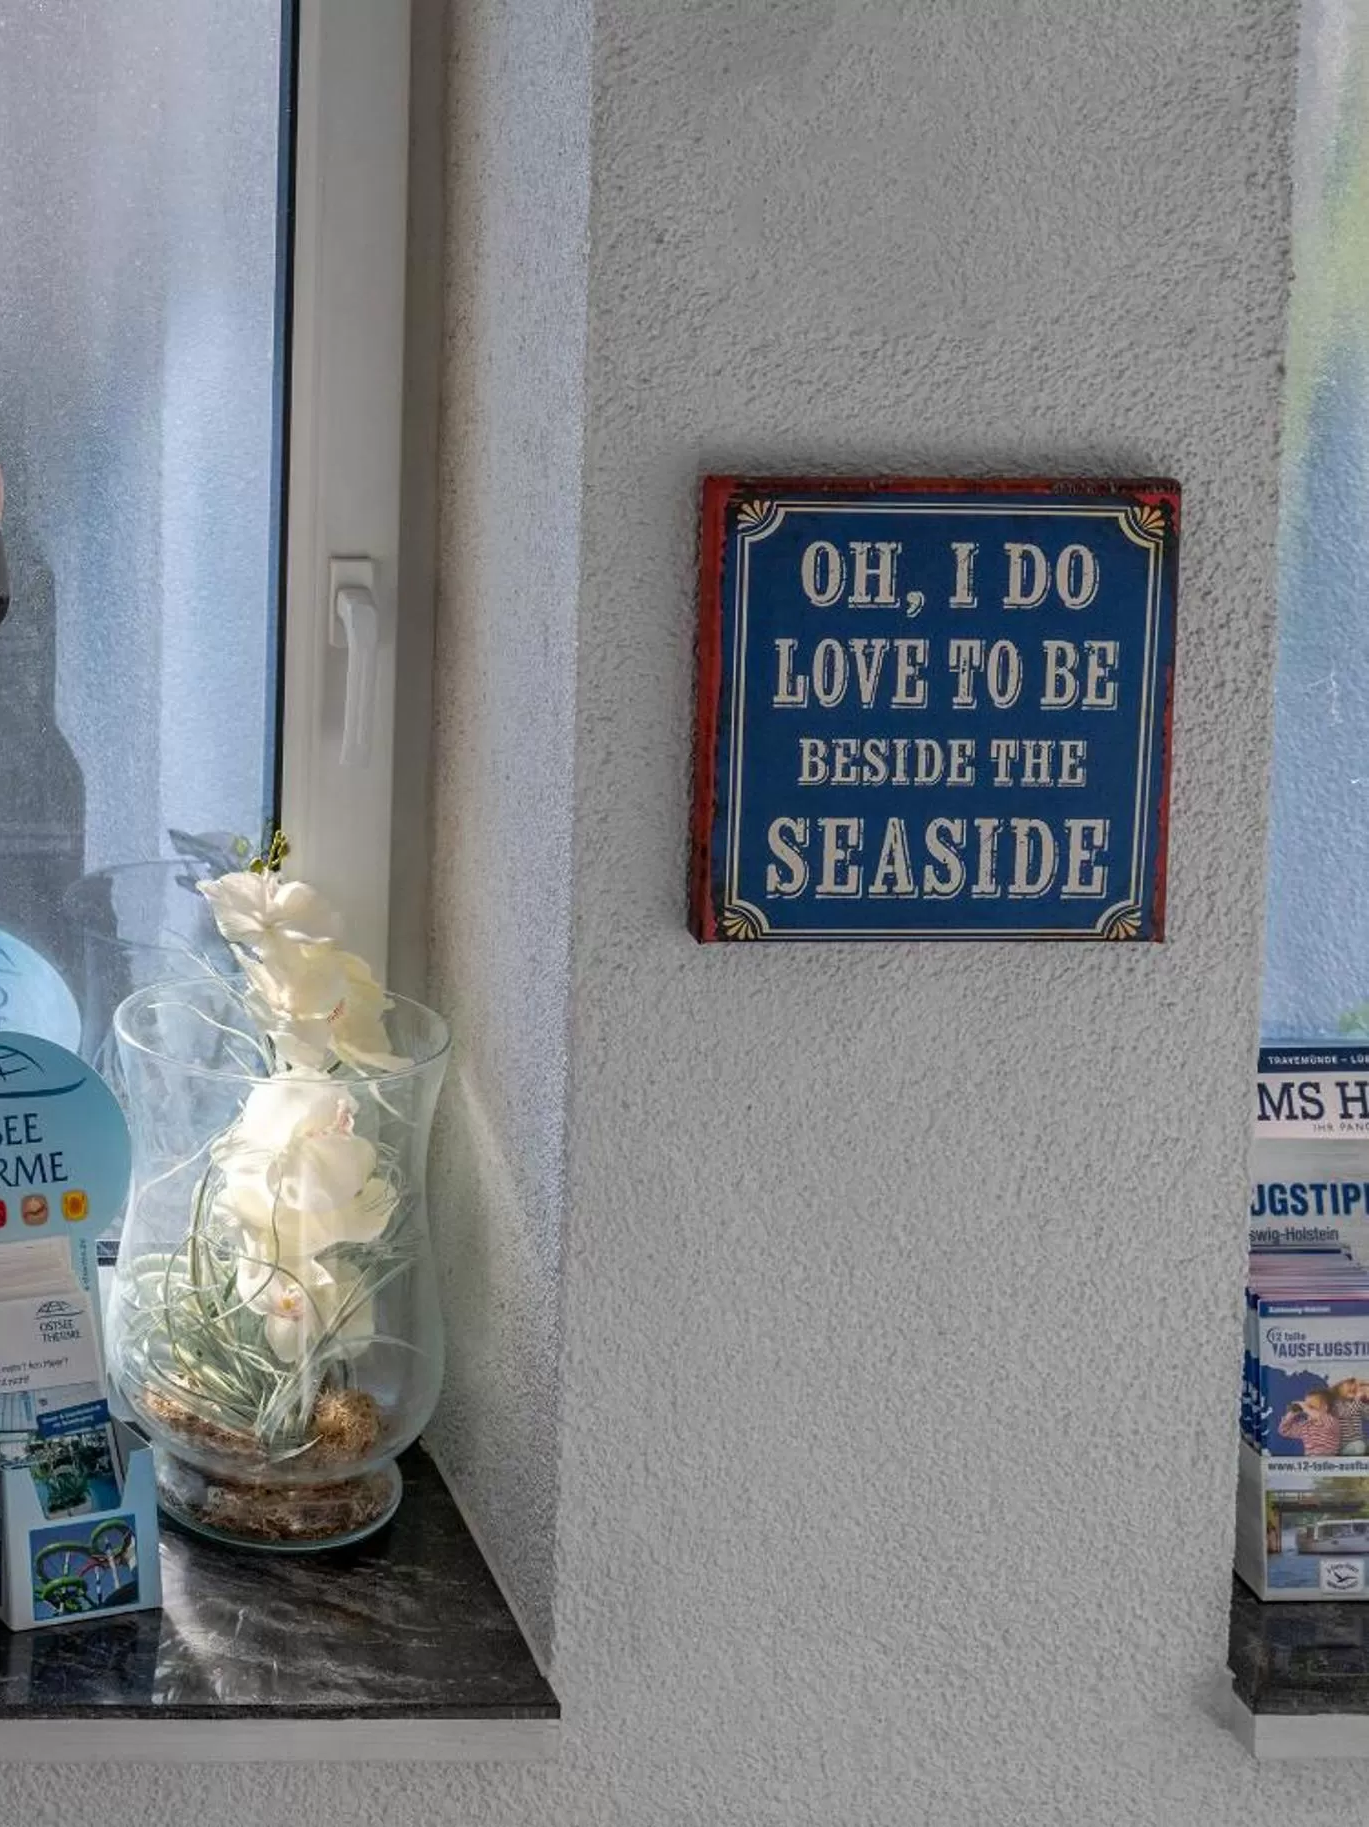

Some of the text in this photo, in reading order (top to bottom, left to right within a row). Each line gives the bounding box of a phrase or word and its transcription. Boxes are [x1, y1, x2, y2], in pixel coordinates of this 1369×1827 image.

[801, 540, 1100, 617] OH, I DO
[773, 638, 1120, 711] LOVE TO BE
[798, 738, 1087, 788] BESIDE THE
[766, 817, 1111, 900] SEASIDE
[1257, 1081, 1325, 1121] MS
